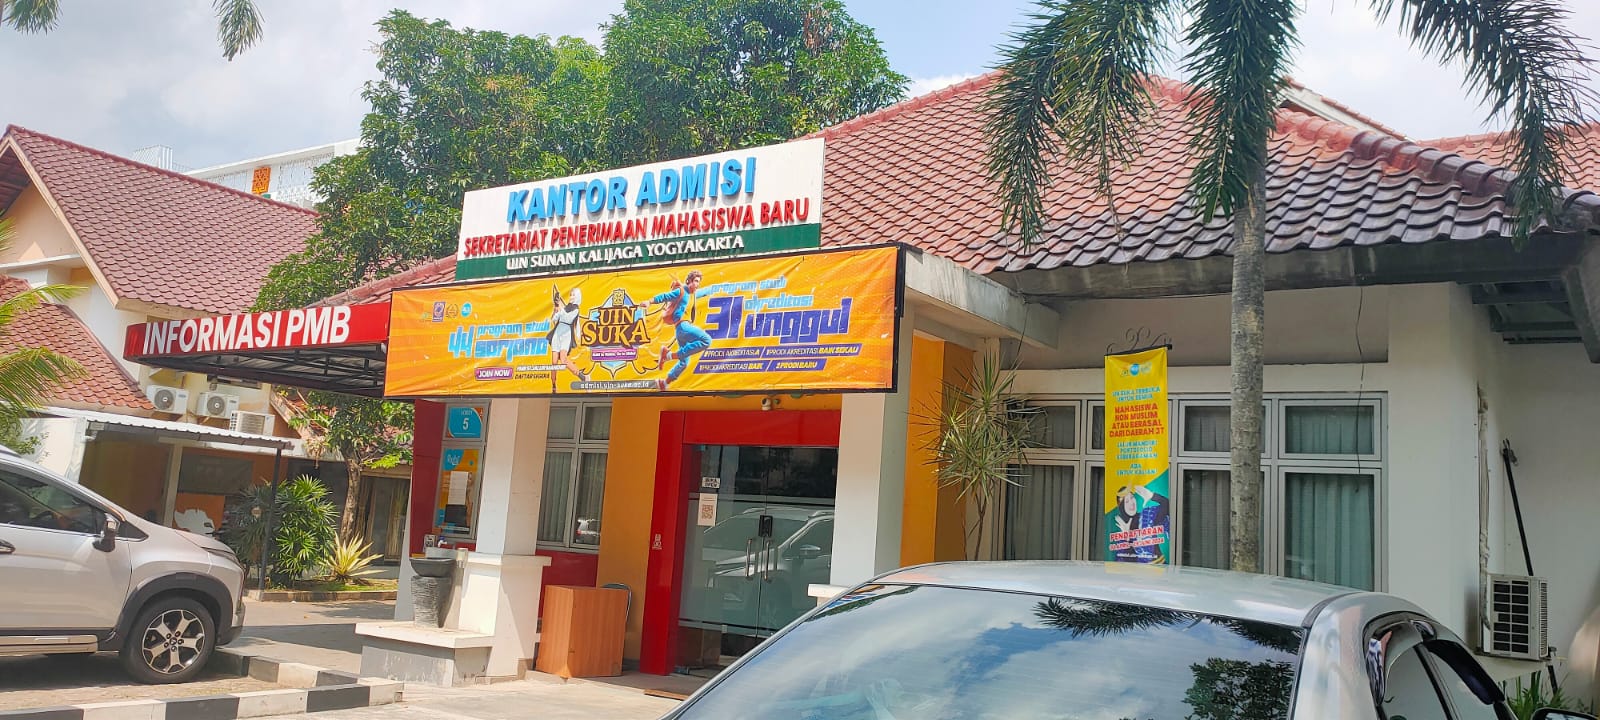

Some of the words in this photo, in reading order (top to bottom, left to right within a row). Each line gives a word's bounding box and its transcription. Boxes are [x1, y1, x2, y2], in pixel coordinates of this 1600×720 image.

[506, 176, 628, 223] KANTOR
[636, 157, 757, 206] ADMISI
[464, 228, 550, 257] SEKRETARIAT
[550, 217, 648, 247] PENERIMAAN
[651, 205, 755, 237] MAHASISWA
[760, 197, 810, 224] BARU
[506, 255, 529, 270] UIN
[530, 251, 576, 268] SUNAN
[578, 245, 643, 264] KALIJAGA
[645, 235, 744, 257] YOGYAKARTA
[759, 275, 787, 290] studi
[599, 307, 637, 326] UIN
[705, 296, 744, 339] 31
[744, 297, 853, 344] unggul
[143, 311, 279, 354] INFORMASI
[285, 305, 351, 346] PMB
[525, 318, 550, 333] studi
[581, 319, 650, 347] SUKA
[448, 326, 475, 358] 44
[478, 370, 494, 378] JOIN
[494, 369, 510, 377] NOW
[1115, 402, 1158, 413] MAHASISWA
[1130, 411, 1158, 419] MUSLIM
[462, 418, 469, 430] 5
[1130, 419, 1162, 428] BERASAL
[1109, 430, 1125, 438] DARI
[1126, 427, 1154, 436] DAERAH
[1110, 526, 1163, 540] PENDAFTARAN
